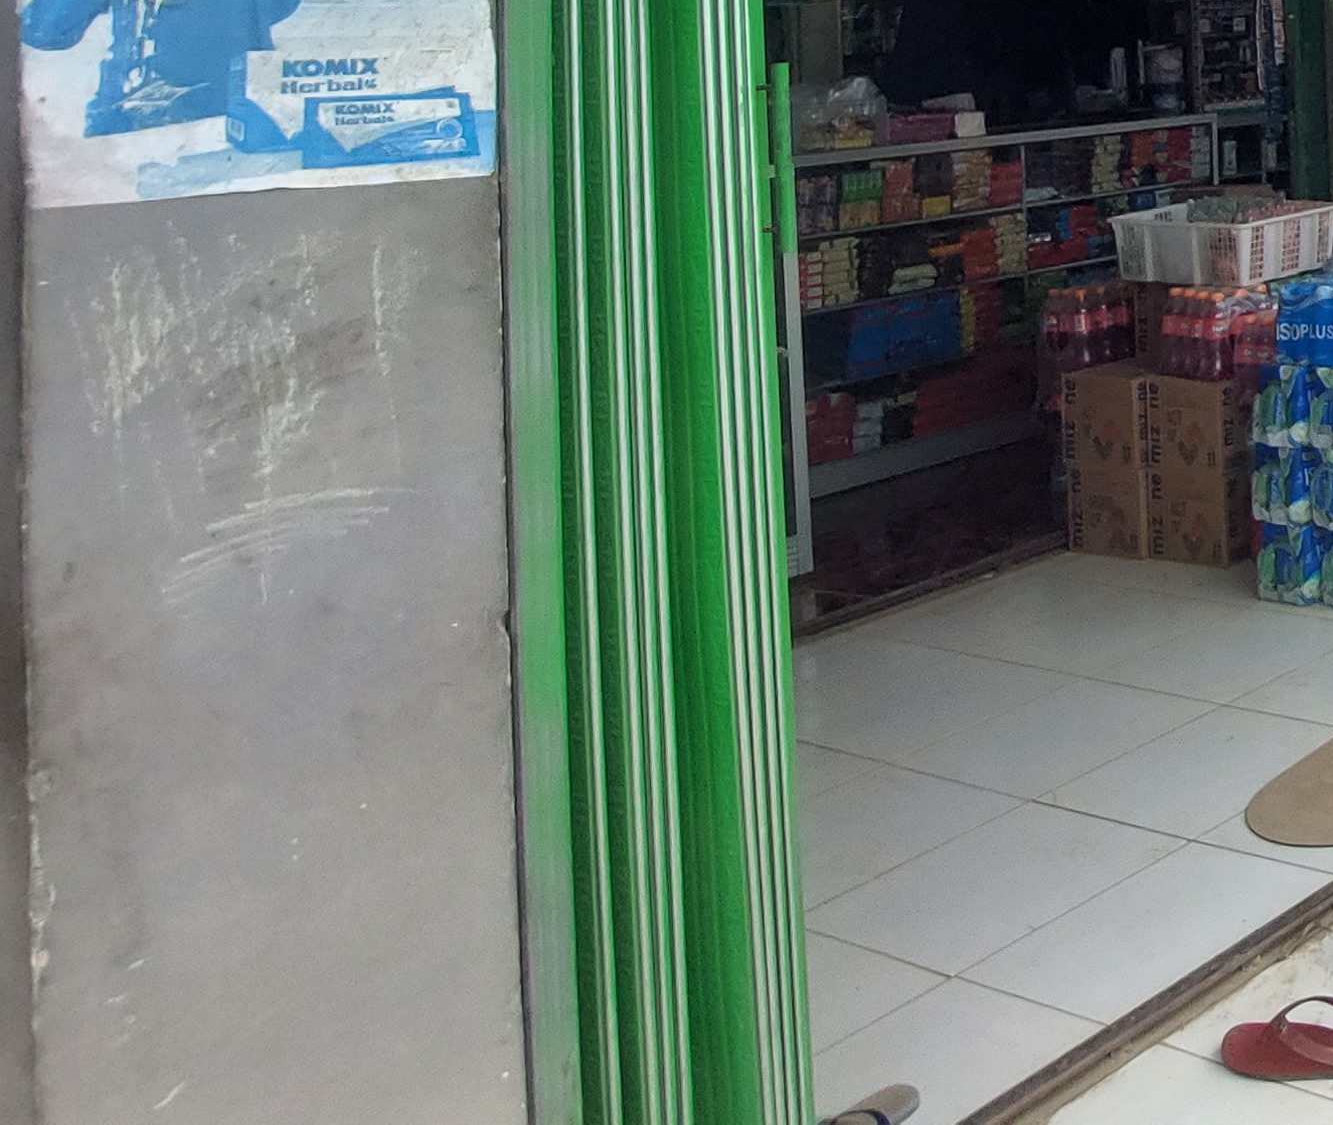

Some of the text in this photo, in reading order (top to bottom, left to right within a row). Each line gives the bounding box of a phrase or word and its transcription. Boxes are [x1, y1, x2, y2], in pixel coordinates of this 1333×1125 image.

[282, 57, 379, 78] KOMIX
[280, 78, 368, 95] Herbal
[335, 103, 395, 115] KOMIX
